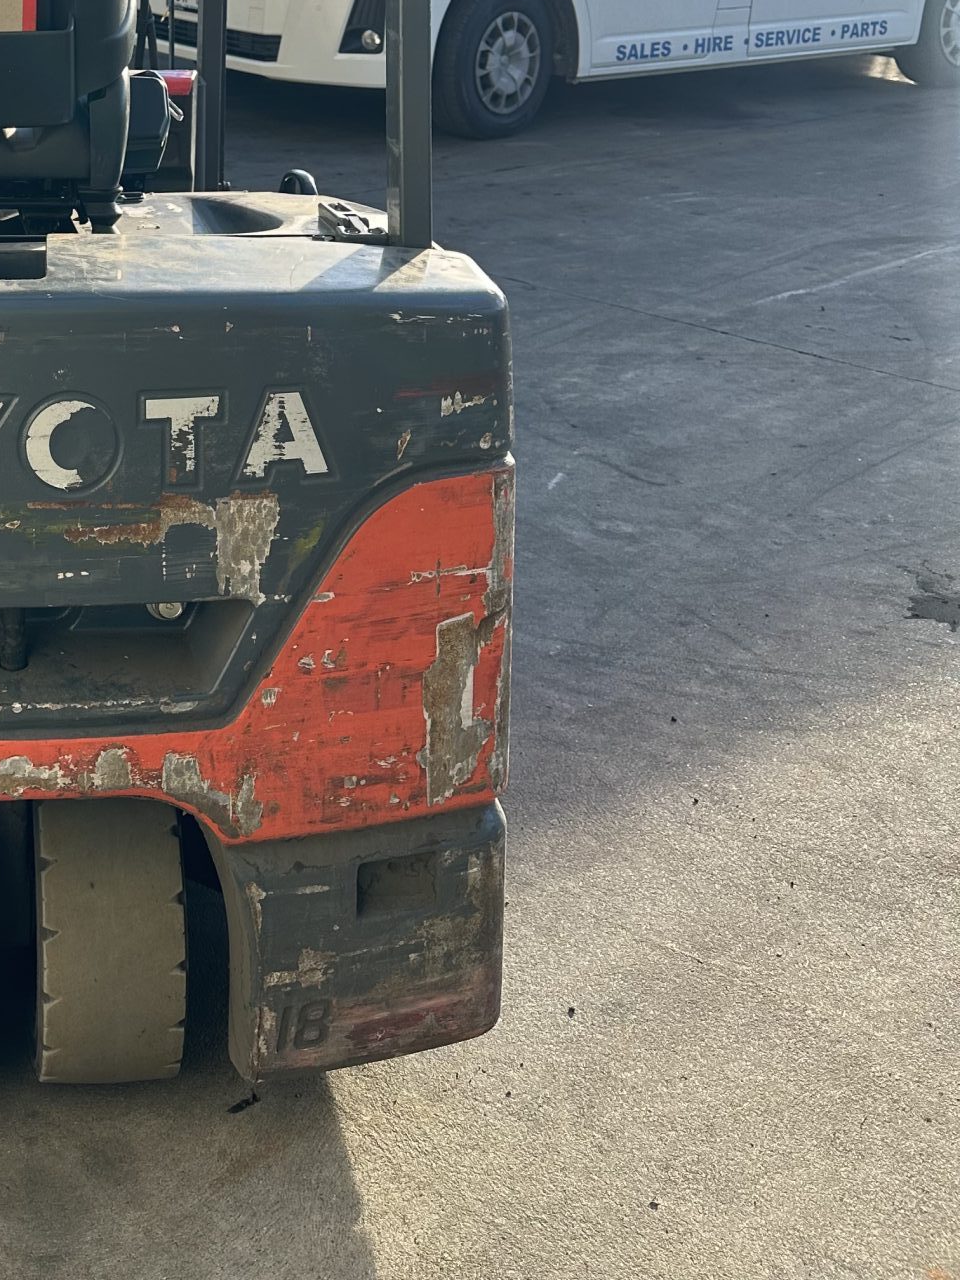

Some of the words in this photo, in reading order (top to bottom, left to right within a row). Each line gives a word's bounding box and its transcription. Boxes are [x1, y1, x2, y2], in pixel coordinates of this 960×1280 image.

[615, 40, 672, 62] SALES
[693, 35, 734, 54] HIRE
[754, 26, 822, 49] SERVICE
[840, 19, 888, 40] PARTS
